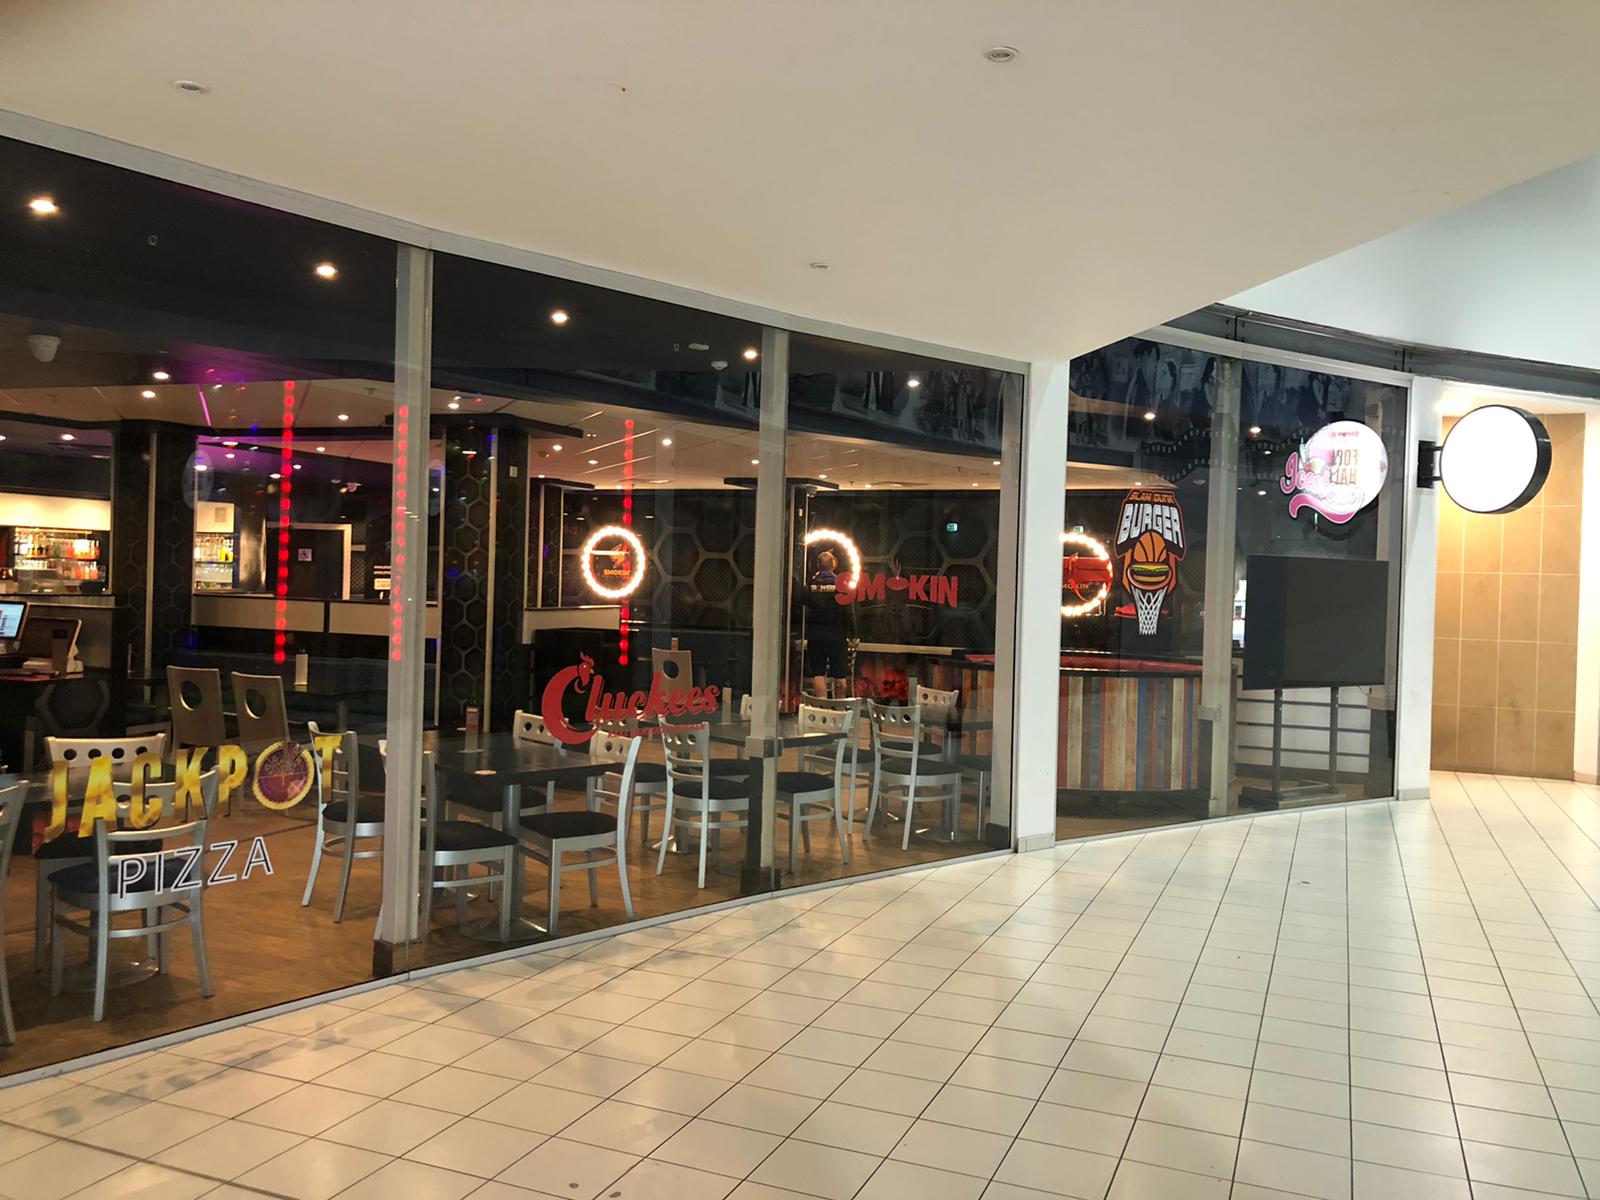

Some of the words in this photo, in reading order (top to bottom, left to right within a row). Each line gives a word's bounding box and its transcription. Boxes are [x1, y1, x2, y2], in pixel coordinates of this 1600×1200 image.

[1117, 503, 1184, 549] BURGER
[834, 570, 960, 609] SMOKIN
[541, 655, 721, 746] Cluckees
[44, 734, 344, 843] JACKPOT
[118, 836, 274, 900] PIZZA
